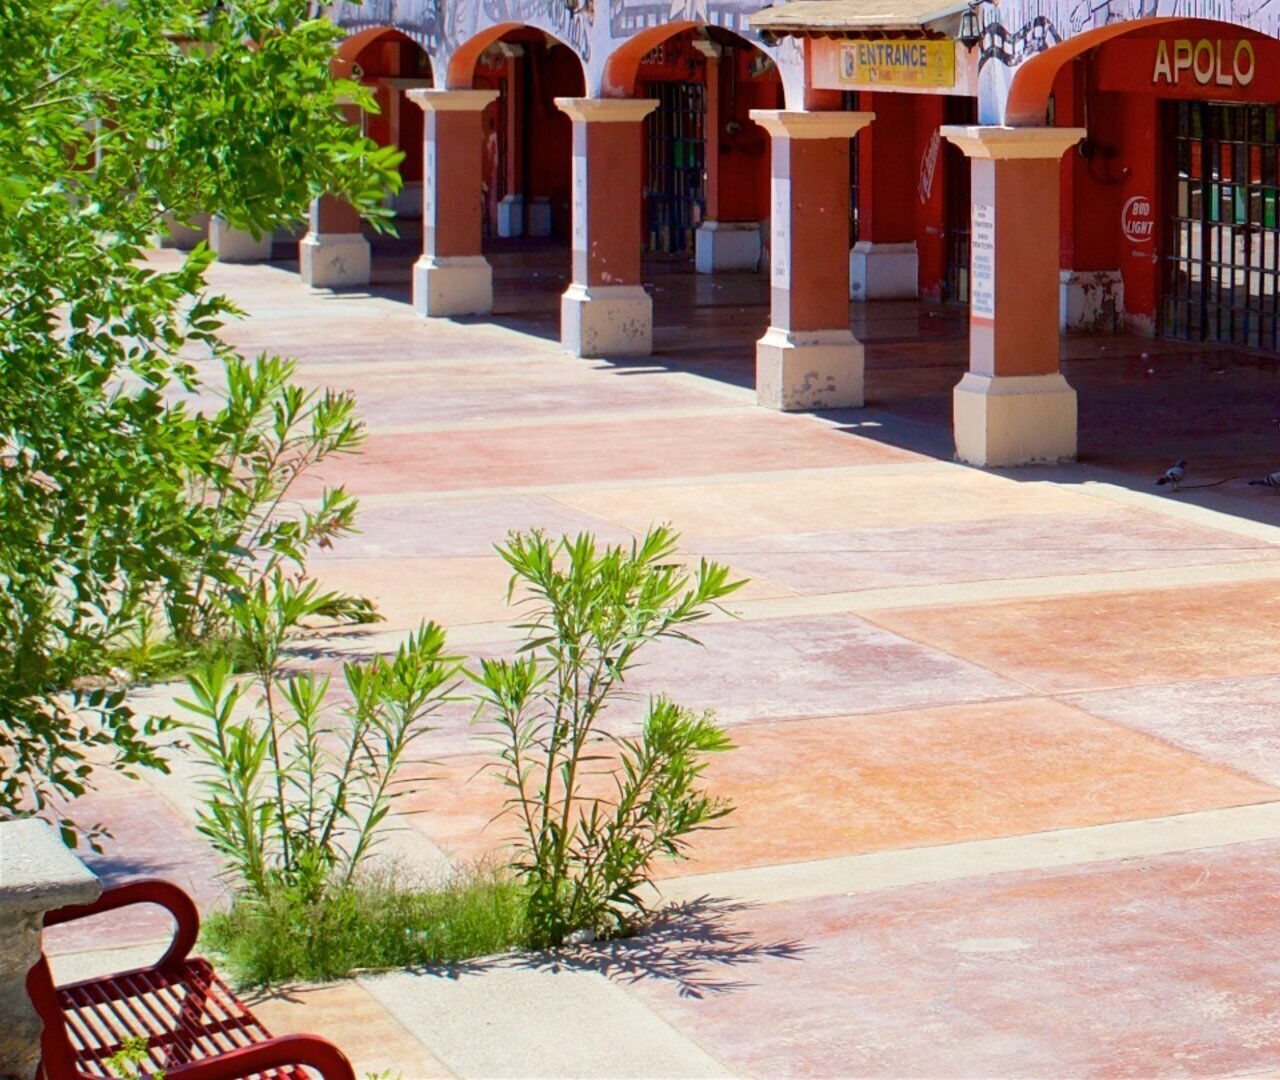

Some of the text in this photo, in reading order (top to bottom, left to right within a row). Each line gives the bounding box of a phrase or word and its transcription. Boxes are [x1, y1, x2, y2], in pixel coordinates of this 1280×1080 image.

[858, 42, 929, 68] ENTRANCE
[1152, 38, 1256, 87] APOLO
[1131, 202, 1150, 216] BUD
[1126, 220, 1154, 234] LIGHT
